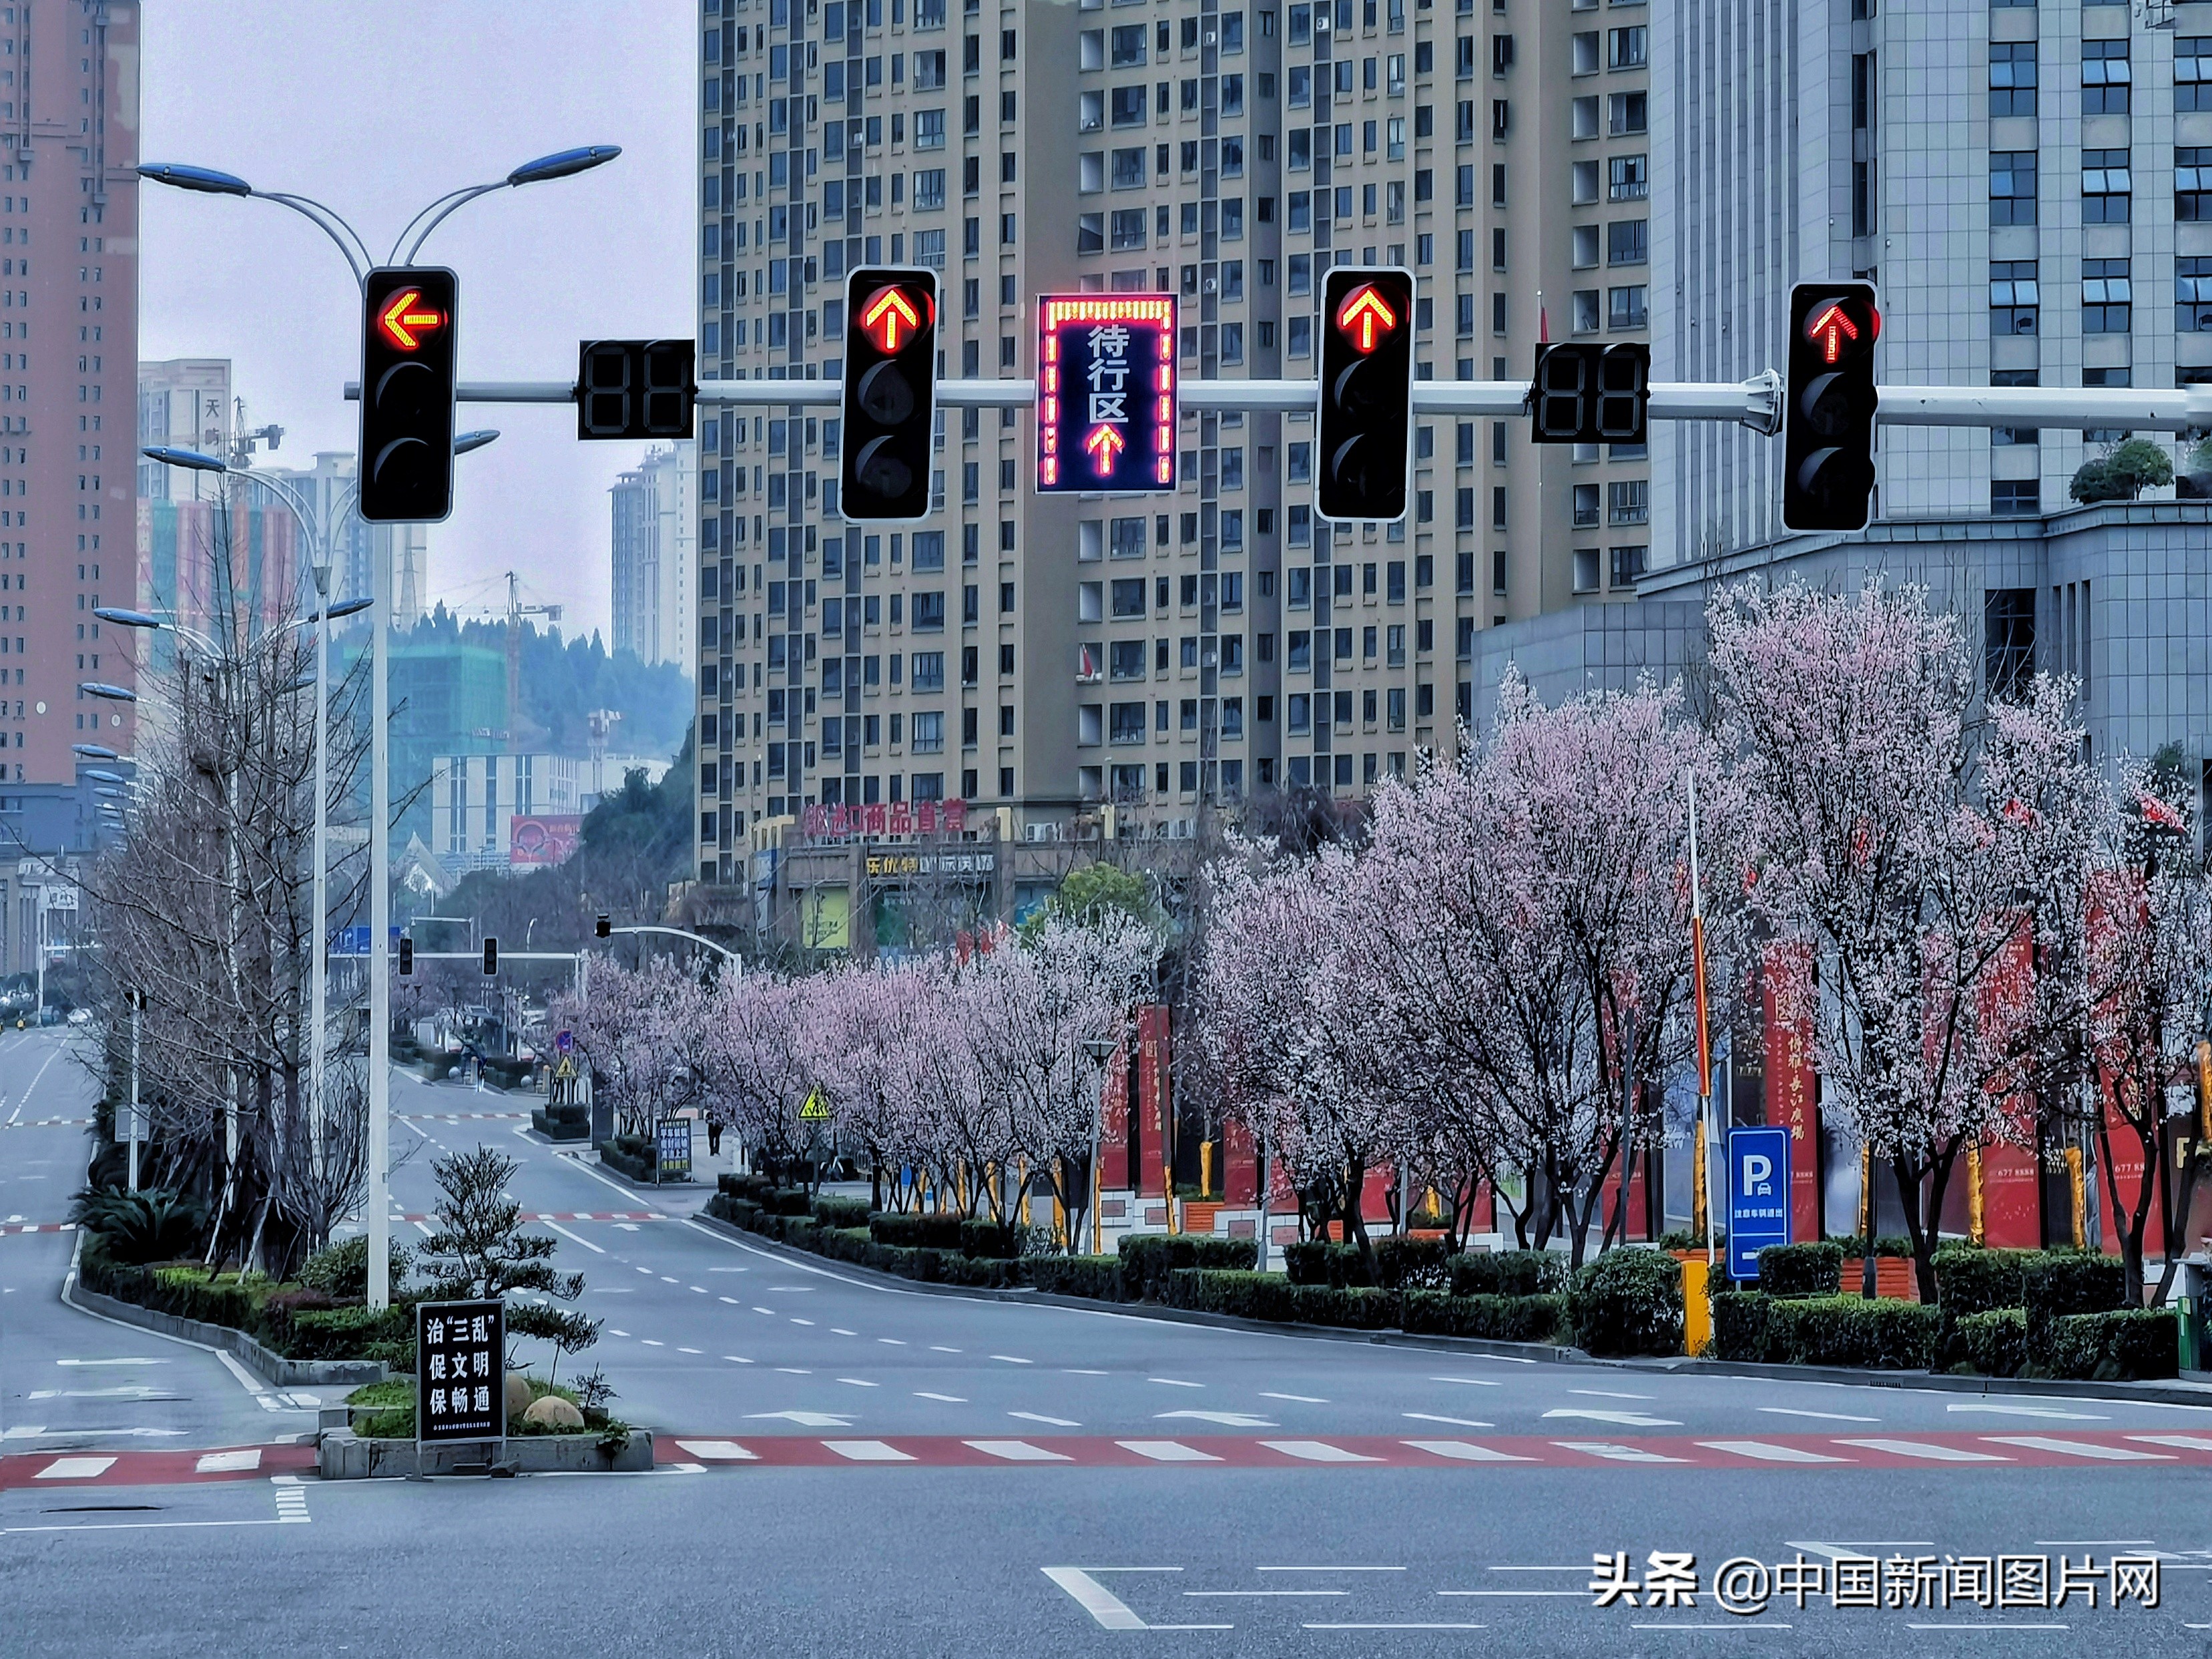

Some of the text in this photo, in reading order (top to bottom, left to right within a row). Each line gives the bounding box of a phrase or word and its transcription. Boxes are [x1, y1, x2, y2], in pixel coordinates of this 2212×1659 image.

[1087, 324, 1129, 423] 待行区
[1743, 1155, 1771, 1196] P
[429, 1351, 489, 1381] 促文明
[430, 1385, 489, 1415] 保畅通
